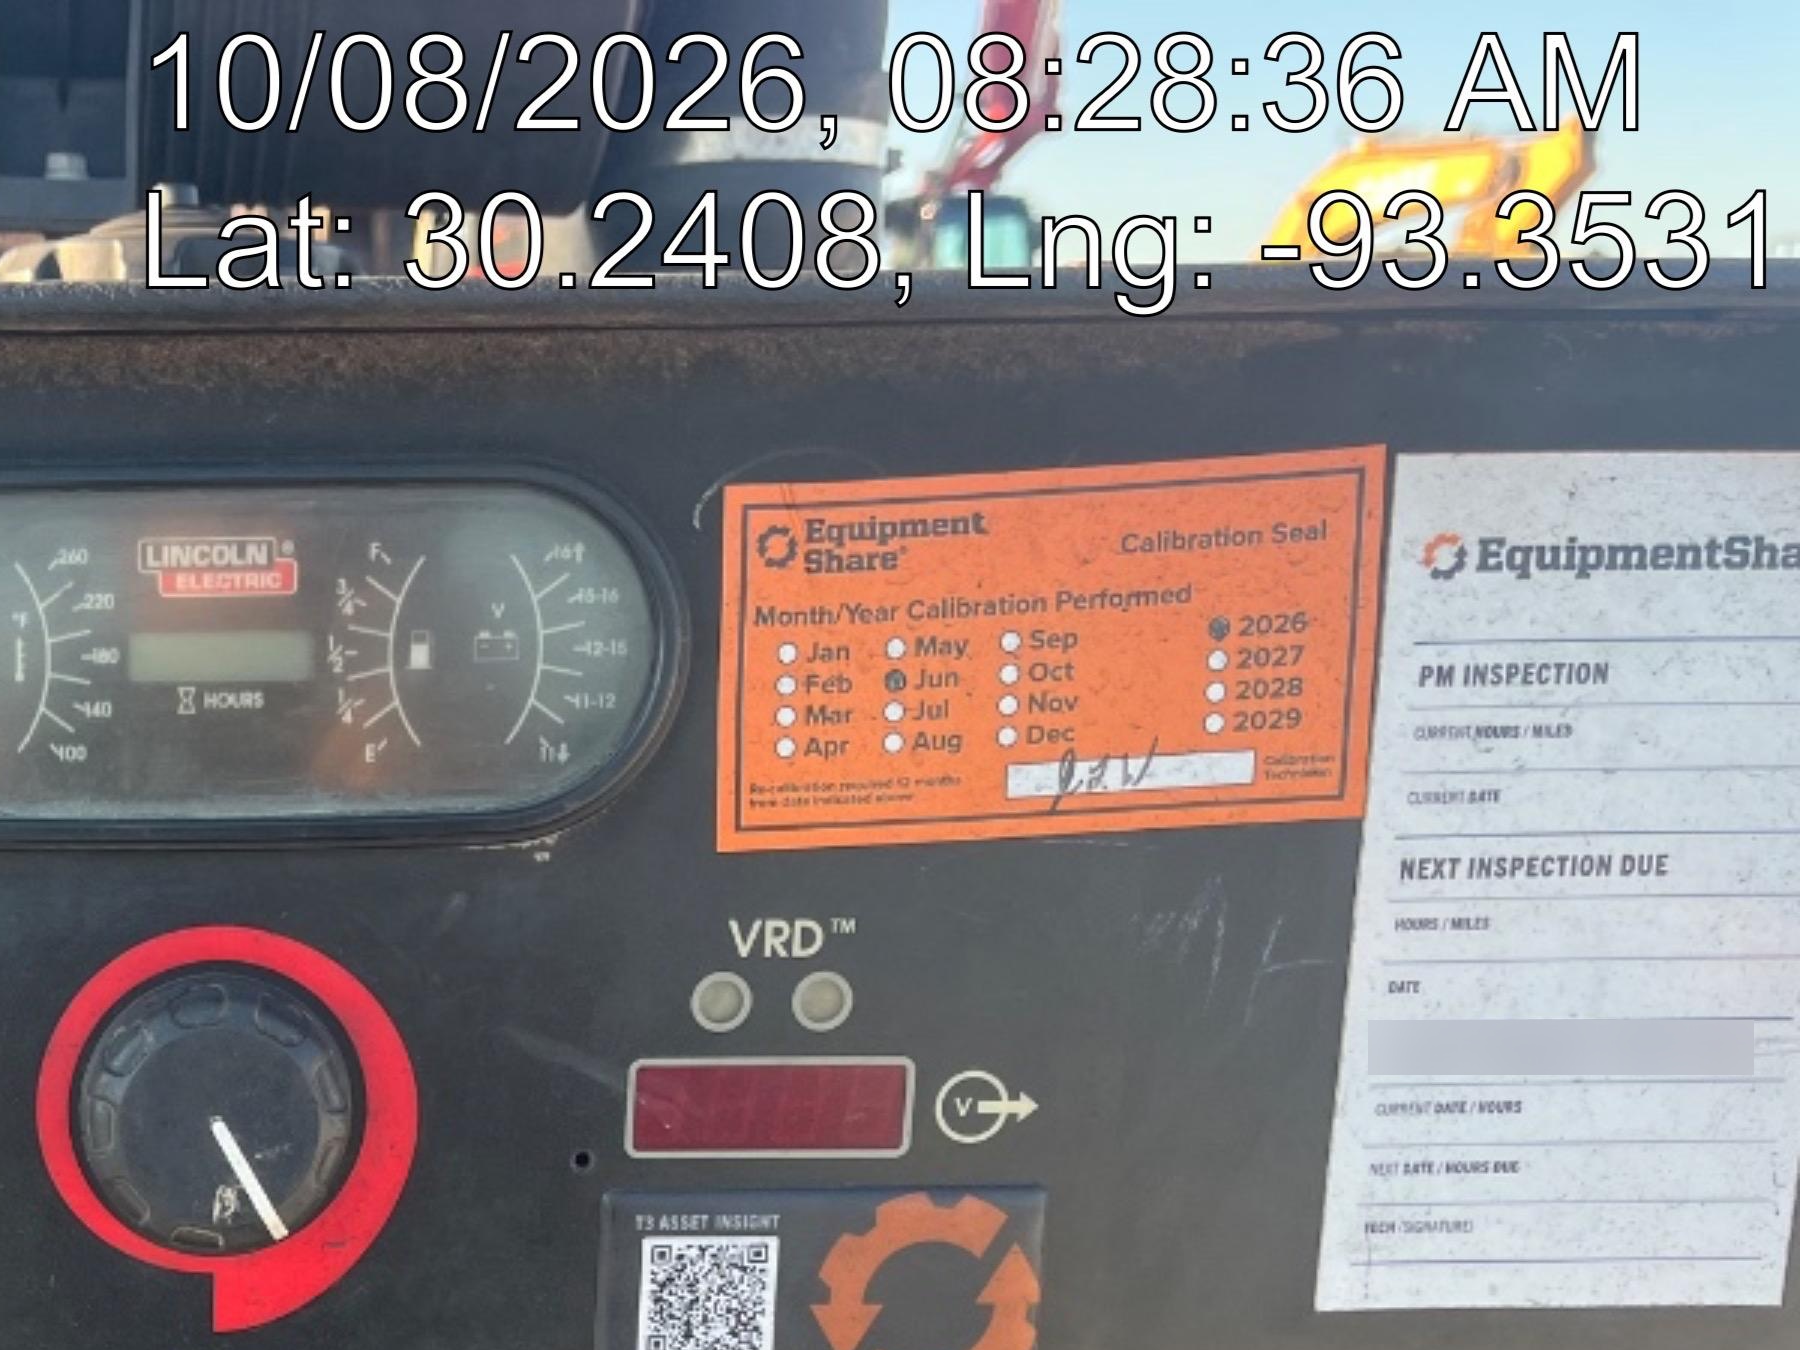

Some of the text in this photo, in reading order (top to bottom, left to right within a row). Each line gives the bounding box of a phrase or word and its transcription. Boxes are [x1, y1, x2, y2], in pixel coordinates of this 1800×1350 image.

[804, 513, 989, 546] Equipment
[1120, 520, 1328, 554] Calibration Seal
[145, 543, 268, 567] LINCOLN
[369, 543, 381, 562] F
[804, 549, 900, 574] Share
[175, 573, 283, 592] ELECTRIC
[491, 603, 505, 620] V
[753, 584, 1193, 628] Month/Year Calibration Performed
[1239, 613, 1309, 636] 2026
[806, 641, 850, 664] Jan
[914, 636, 970, 661] May
[1028, 630, 1079, 654] Sep
[1236, 645, 1305, 670] 2027
[914, 668, 960, 690] Jun
[1028, 661, 1075, 683] Oct
[1418, 662, 1610, 688] PM INSPECTION
[804, 673, 853, 694] Feb
[1234, 678, 1303, 700] 2028
[203, 690, 265, 709] HOURS
[913, 699, 949, 720] Jul
[1027, 693, 1079, 714] Nov
[804, 704, 853, 727] Mar
[1232, 708, 1302, 732] 2029
[912, 731, 963, 754] Aug
[1025, 725, 1076, 745] Dec
[365, 744, 376, 763] E
[803, 737, 850, 761] Apr
[1400, 853, 1670, 881] NEXT INSPECTION DUE
[1394, 916, 1490, 931] HOURS MILES
[1388, 980, 1421, 994] DATE
[956, 1098, 973, 1116] V
[1478, 1100, 1523, 1114] HOURS
[659, 1214, 709, 1231] ASSET
[713, 1213, 781, 1230] INSIGHT
